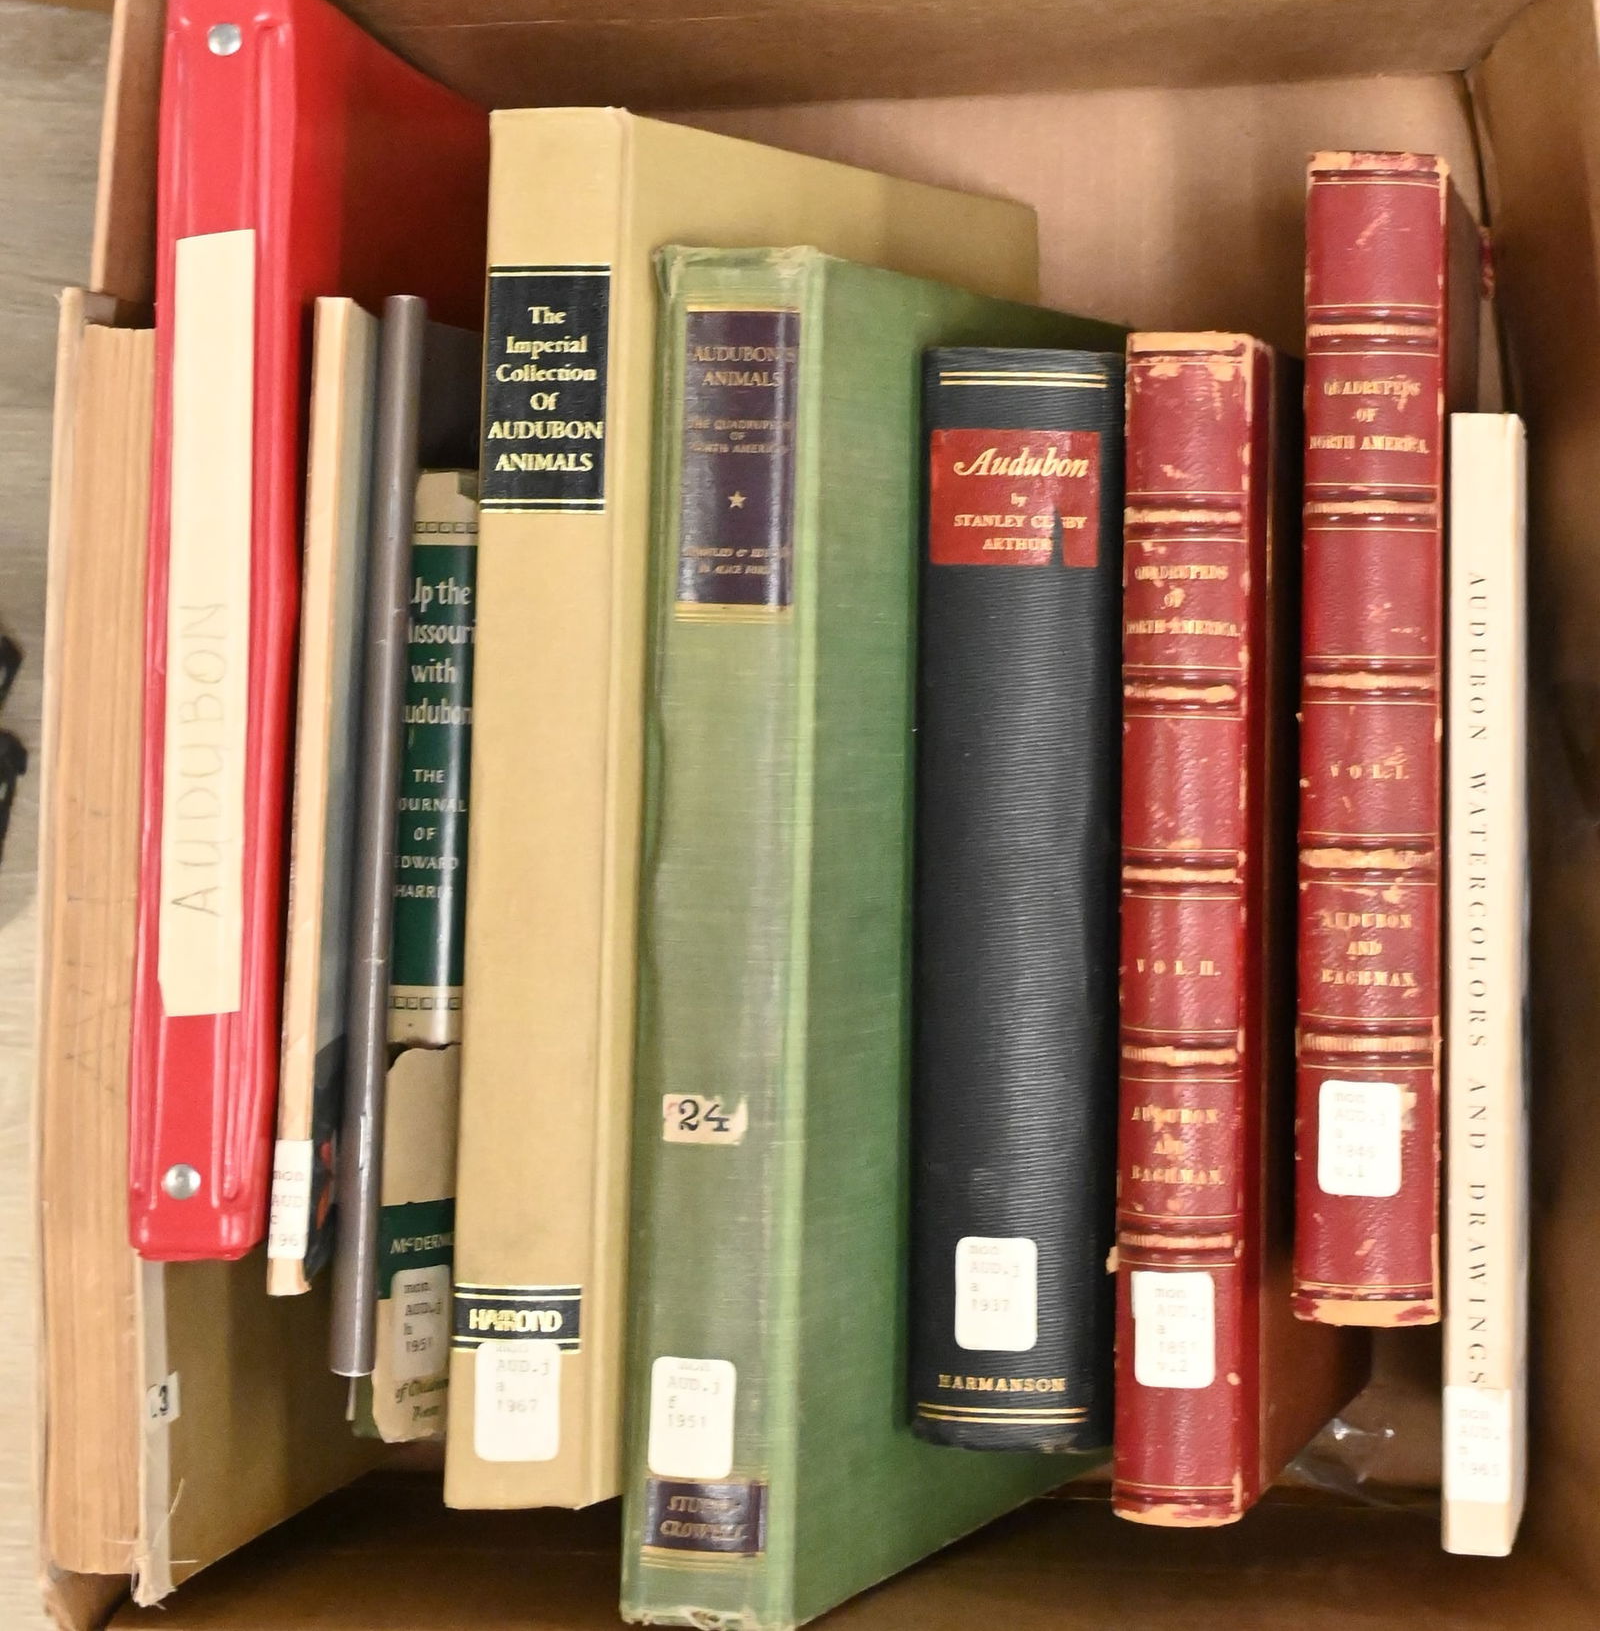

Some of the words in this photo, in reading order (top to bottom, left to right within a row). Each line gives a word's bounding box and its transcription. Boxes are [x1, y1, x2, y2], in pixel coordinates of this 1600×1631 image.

[527, 305, 567, 326] The
[505, 335, 587, 359] Imperial
[495, 362, 597, 384] Collection
[702, 370, 783, 388] ANIMALS
[529, 392, 559, 411] Of
[487, 420, 604, 441] AUDUBON
[728, 430, 745, 441] OF
[494, 452, 594, 472] ANIMALS
[953, 446, 1089, 478] Audubon
[1010, 492, 1029, 507] by
[953, 514, 1026, 528] STANLEY
[982, 537, 1053, 551] ARTHUR
[435, 576, 473, 606] the
[408, 617, 476, 644] issouri
[1468, 571, 1490, 744] AUDUBON
[410, 657, 459, 684] with
[401, 697, 474, 725] udubon
[169, 601, 233, 919] AUDUBON
[412, 769, 446, 785] THE
[398, 796, 468, 814] OURNAL
[412, 827, 438, 843] OF
[1320, 911, 1413, 929] AUDUBON
[1469, 771, 1490, 1051] WATERCOLORS
[1346, 940, 1383, 956] AND
[678, 1098, 730, 1133] 24
[1469, 1078, 1490, 1153] AND
[1469, 1183, 1491, 1388] DRAWINGS
[937, 1374, 1068, 1393] HARMANSON
